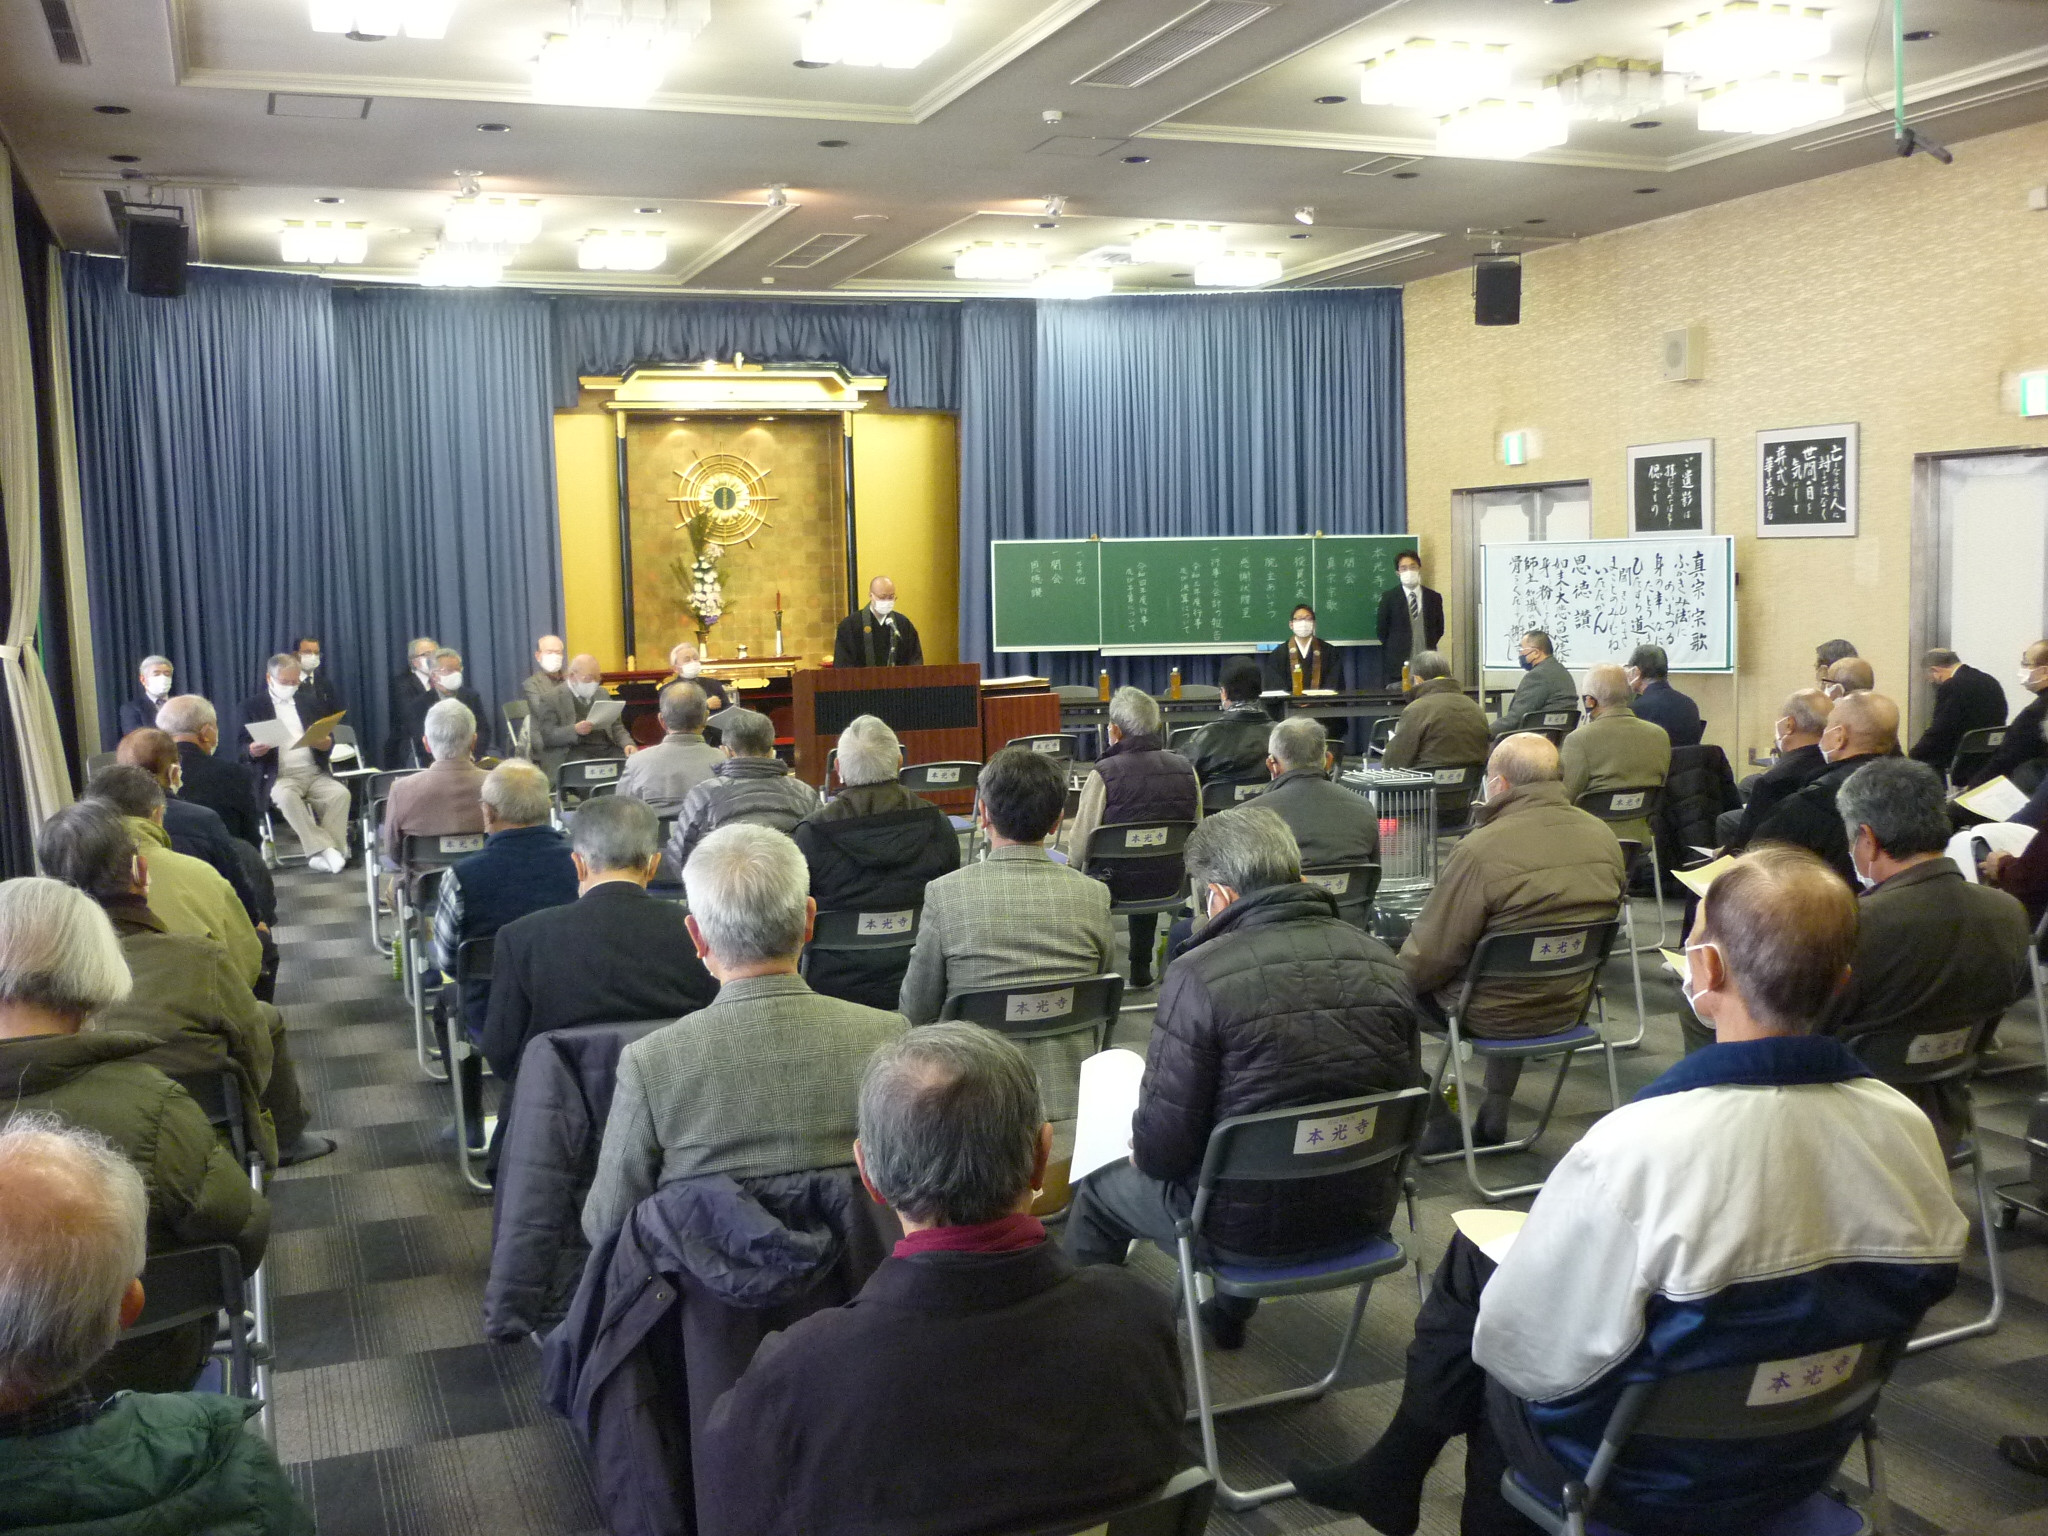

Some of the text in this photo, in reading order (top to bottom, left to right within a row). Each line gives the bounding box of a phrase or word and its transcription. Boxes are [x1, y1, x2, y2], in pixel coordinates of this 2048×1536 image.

[1774, 445, 1788, 496] 葬式は
[1791, 458, 1803, 514] 気にして
[931, 772, 956, 781] 本光寺
[1616, 798, 1640, 807] 本光寺
[1132, 831, 1163, 844] 本光寺
[865, 916, 907, 930] 本光寺
[1540, 939, 1582, 955] 本光寺
[1015, 997, 1068, 1015] 本光寺
[1306, 1118, 1369, 1145] 本光寺
[1767, 1354, 1850, 1395] 本光寺
